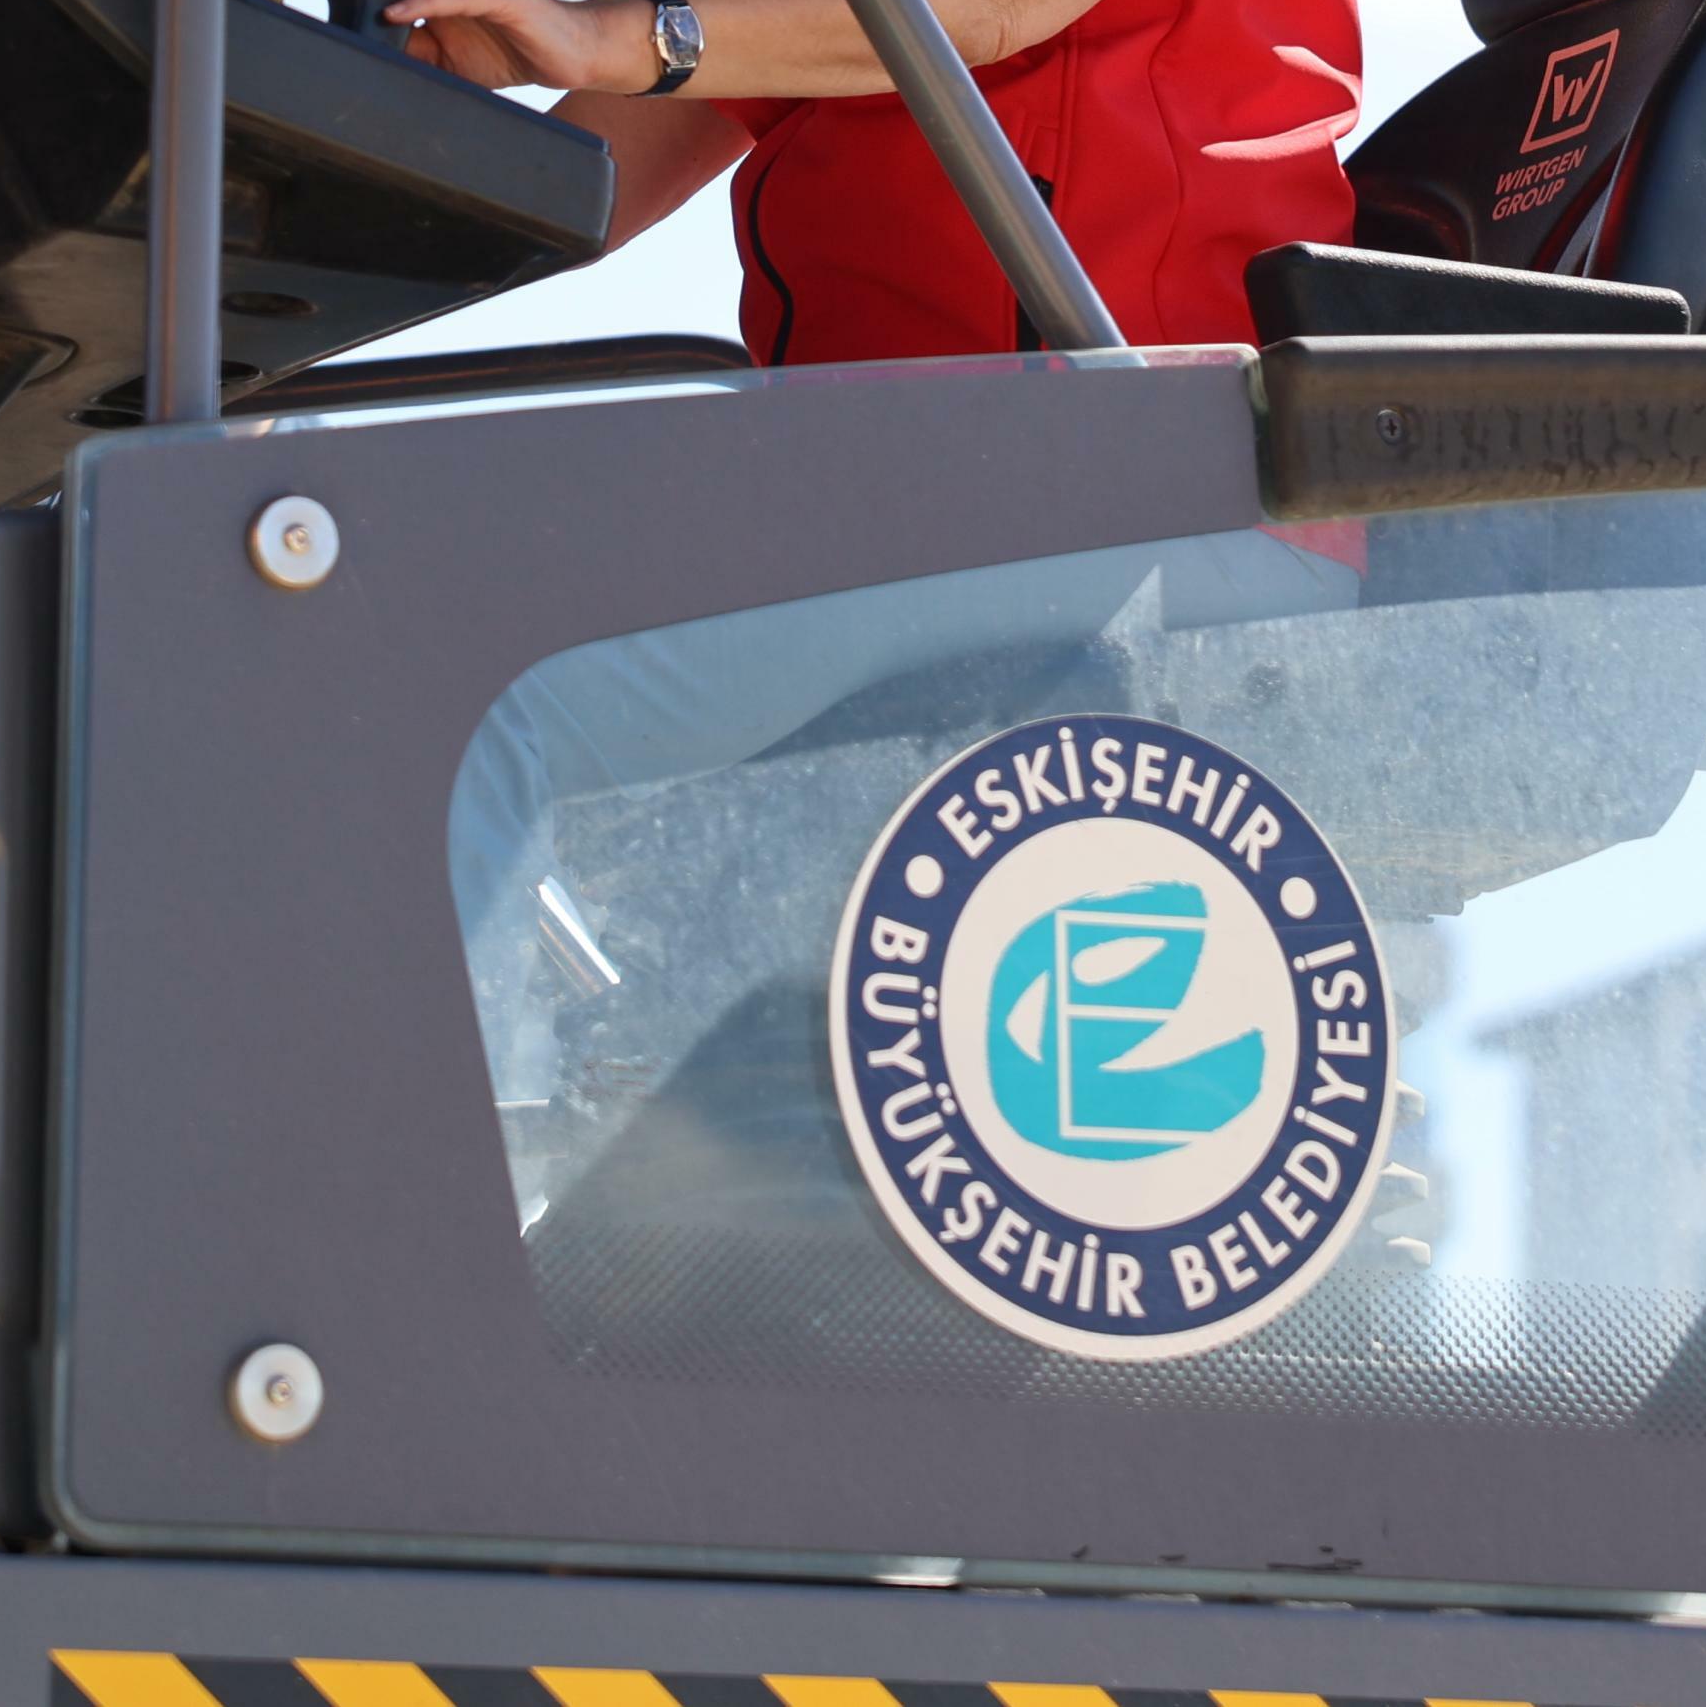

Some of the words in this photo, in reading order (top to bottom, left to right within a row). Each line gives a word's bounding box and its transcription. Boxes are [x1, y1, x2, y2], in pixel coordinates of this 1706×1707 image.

[1492, 178, 1566, 221] GROUP
[1495, 145, 1588, 194] WIRTGEN
[936, 727, 1282, 873] ESKİŞEHİR
[862, 915, 1147, 1318] BÜYÜKŞEHİR
[1171, 939, 1372, 1310] BELEDİYESİ
